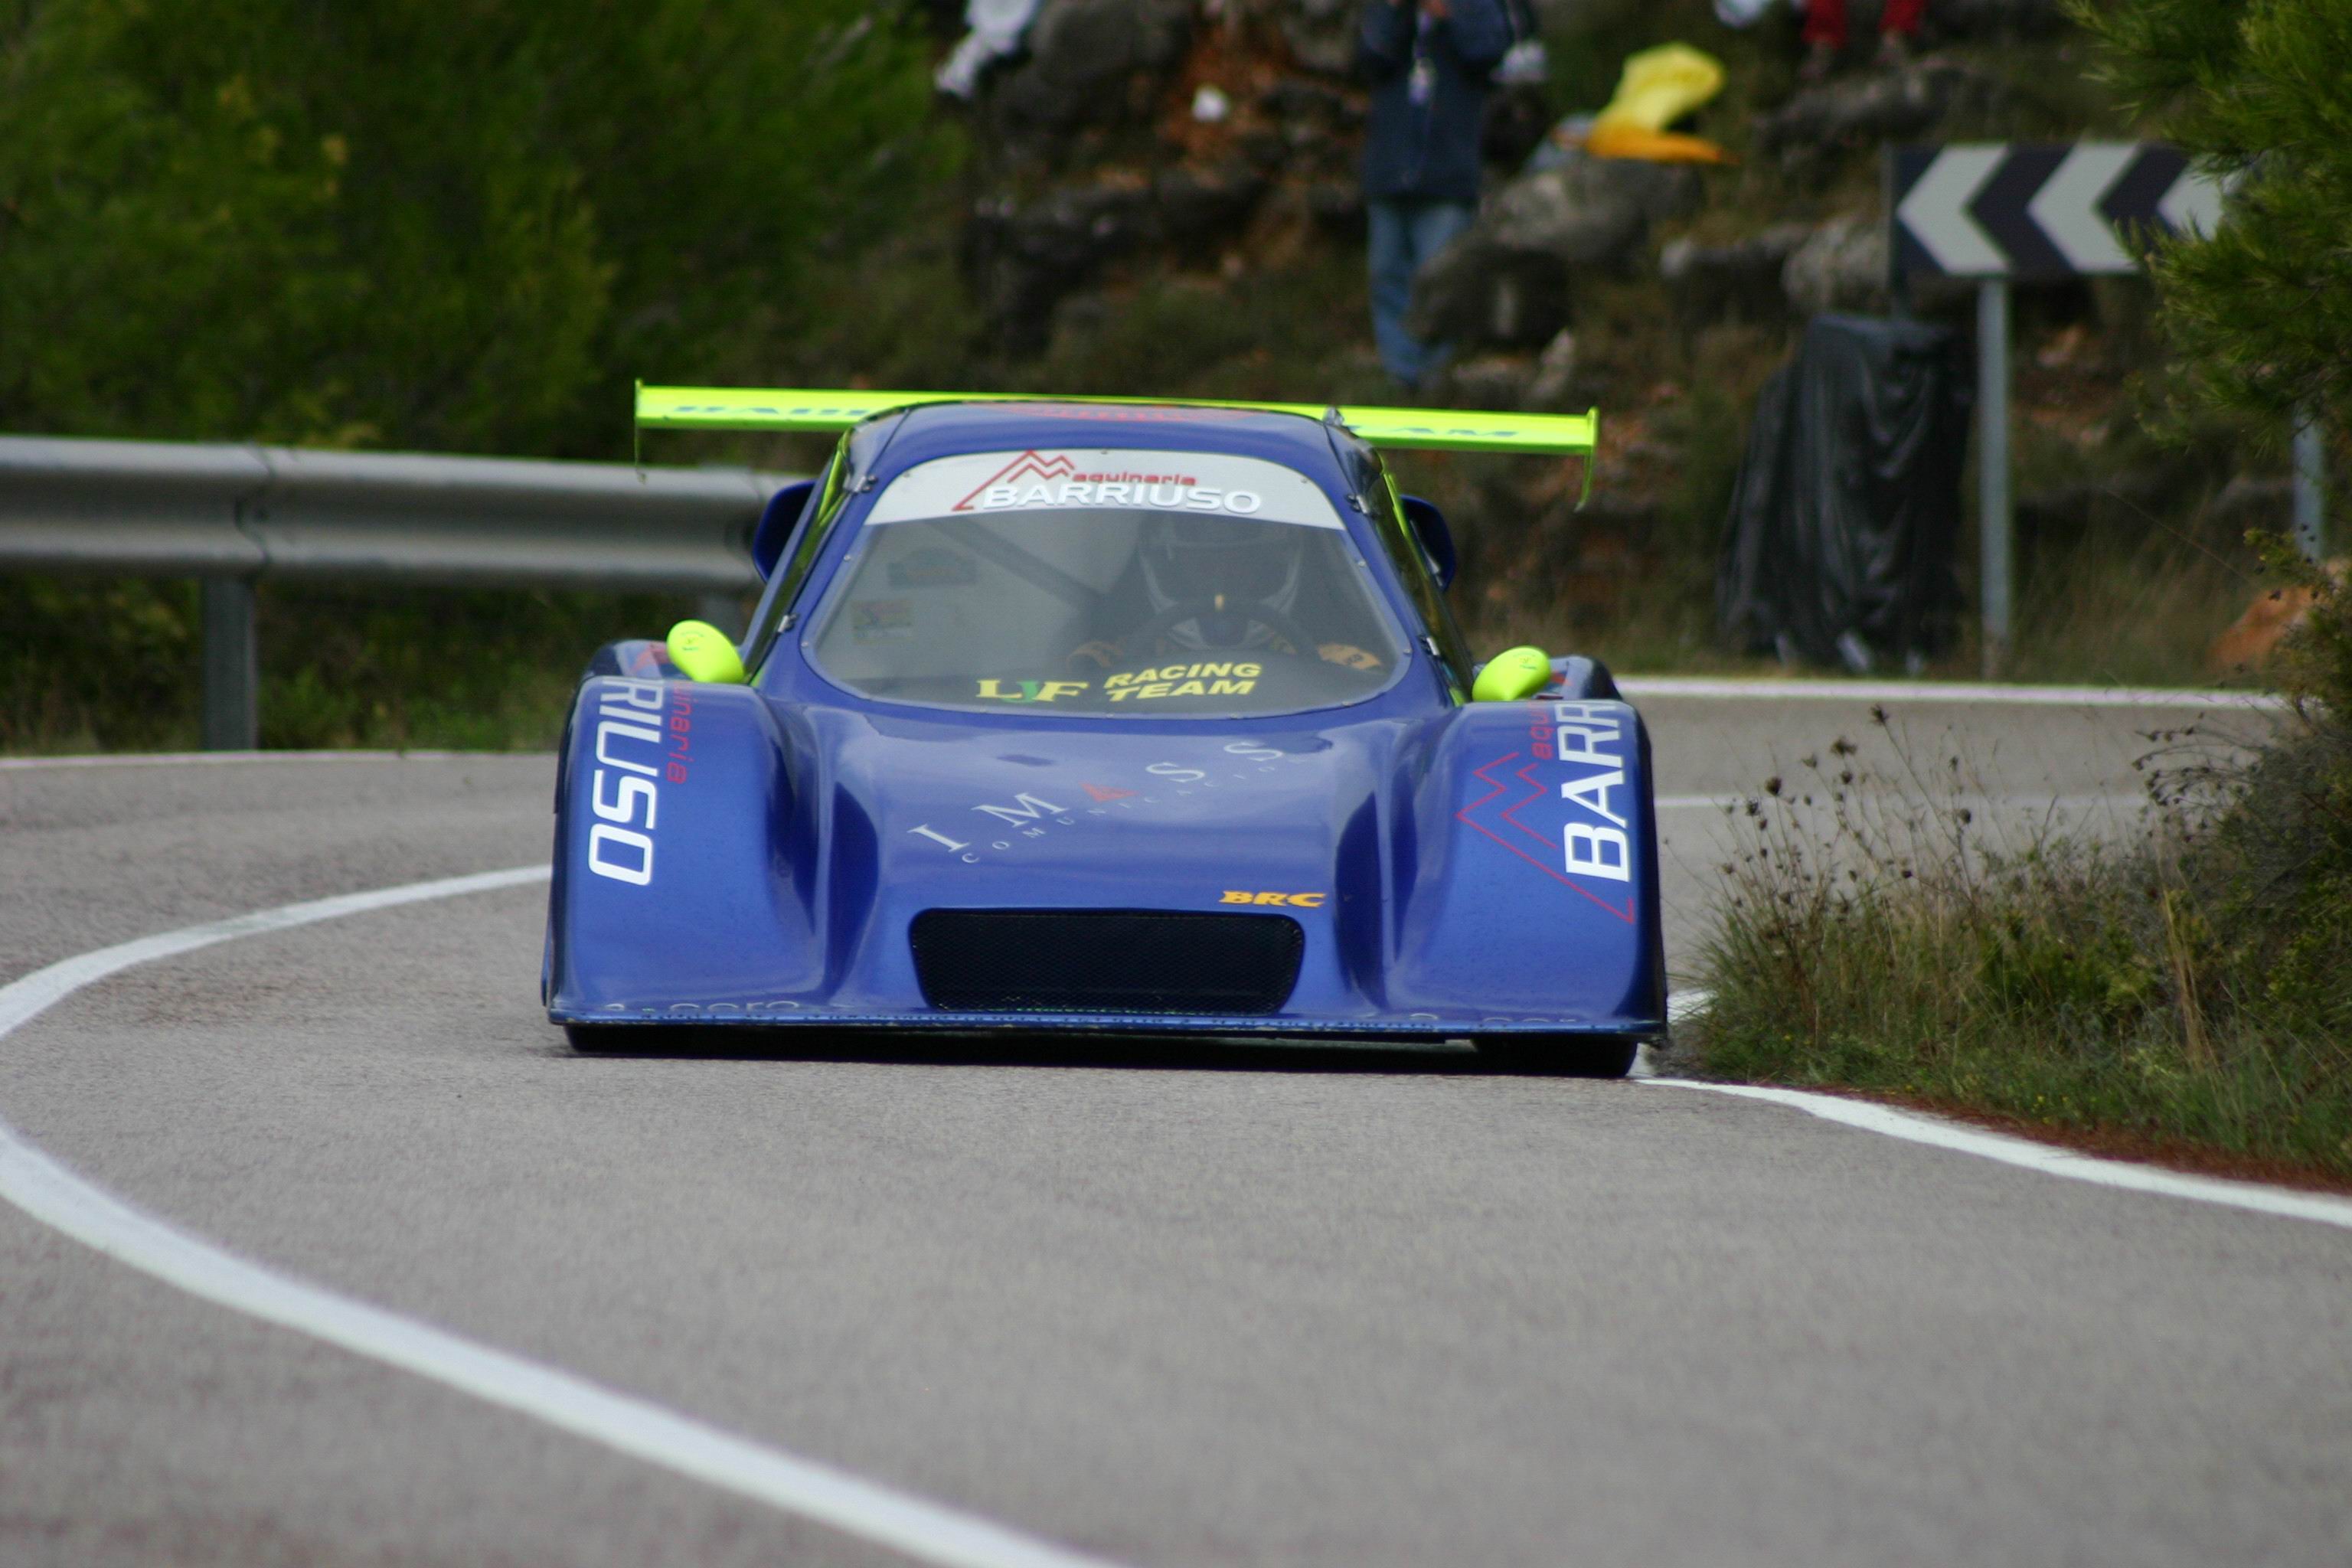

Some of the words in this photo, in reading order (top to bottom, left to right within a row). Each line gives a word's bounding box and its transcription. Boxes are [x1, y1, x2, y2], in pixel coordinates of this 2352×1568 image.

[983, 482, 1262, 514] BARRIUSO
[1103, 662, 1263, 690] RACING
[1106, 679, 1256, 702] TEAM
[1219, 890, 1327, 908] BRC
